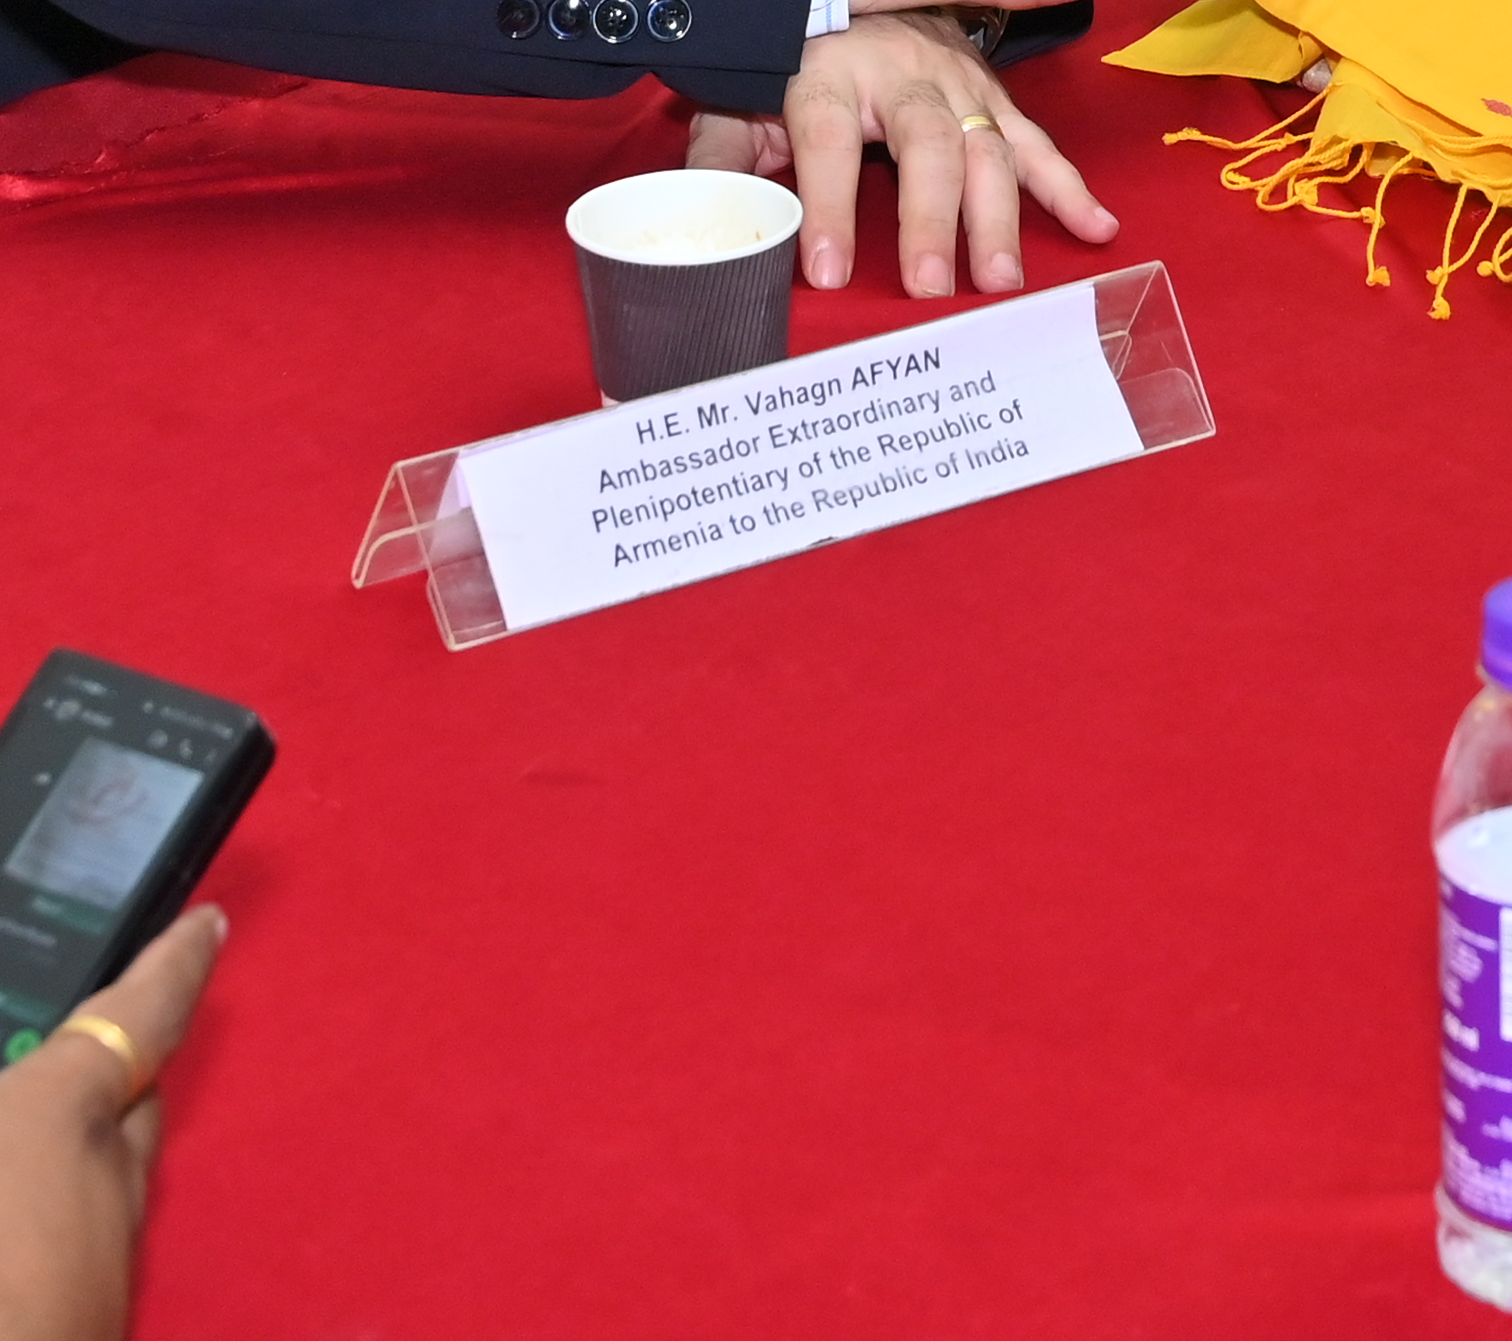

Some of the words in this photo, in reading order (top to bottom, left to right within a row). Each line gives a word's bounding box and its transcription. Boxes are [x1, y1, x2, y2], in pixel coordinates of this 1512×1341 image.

[635, 412, 690, 445] H.E.
[696, 402, 738, 430] Mr.
[744, 378, 842, 416] Vahagn
[851, 346, 941, 391] AFYAN
[998, 398, 1023, 424] of
[599, 436, 760, 494] Ambassador
[768, 389, 940, 449] Extraordinary
[949, 369, 996, 402] and
[935, 452, 960, 478] of
[965, 438, 1029, 470] India
[591, 467, 788, 534] Plenipotentiary
[798, 451, 823, 478] of
[829, 446, 872, 470] the
[876, 413, 992, 457] Republic
[811, 468, 928, 513] Republic
[728, 514, 756, 535] to
[762, 502, 806, 526] the
[614, 523, 723, 568] Armenia
